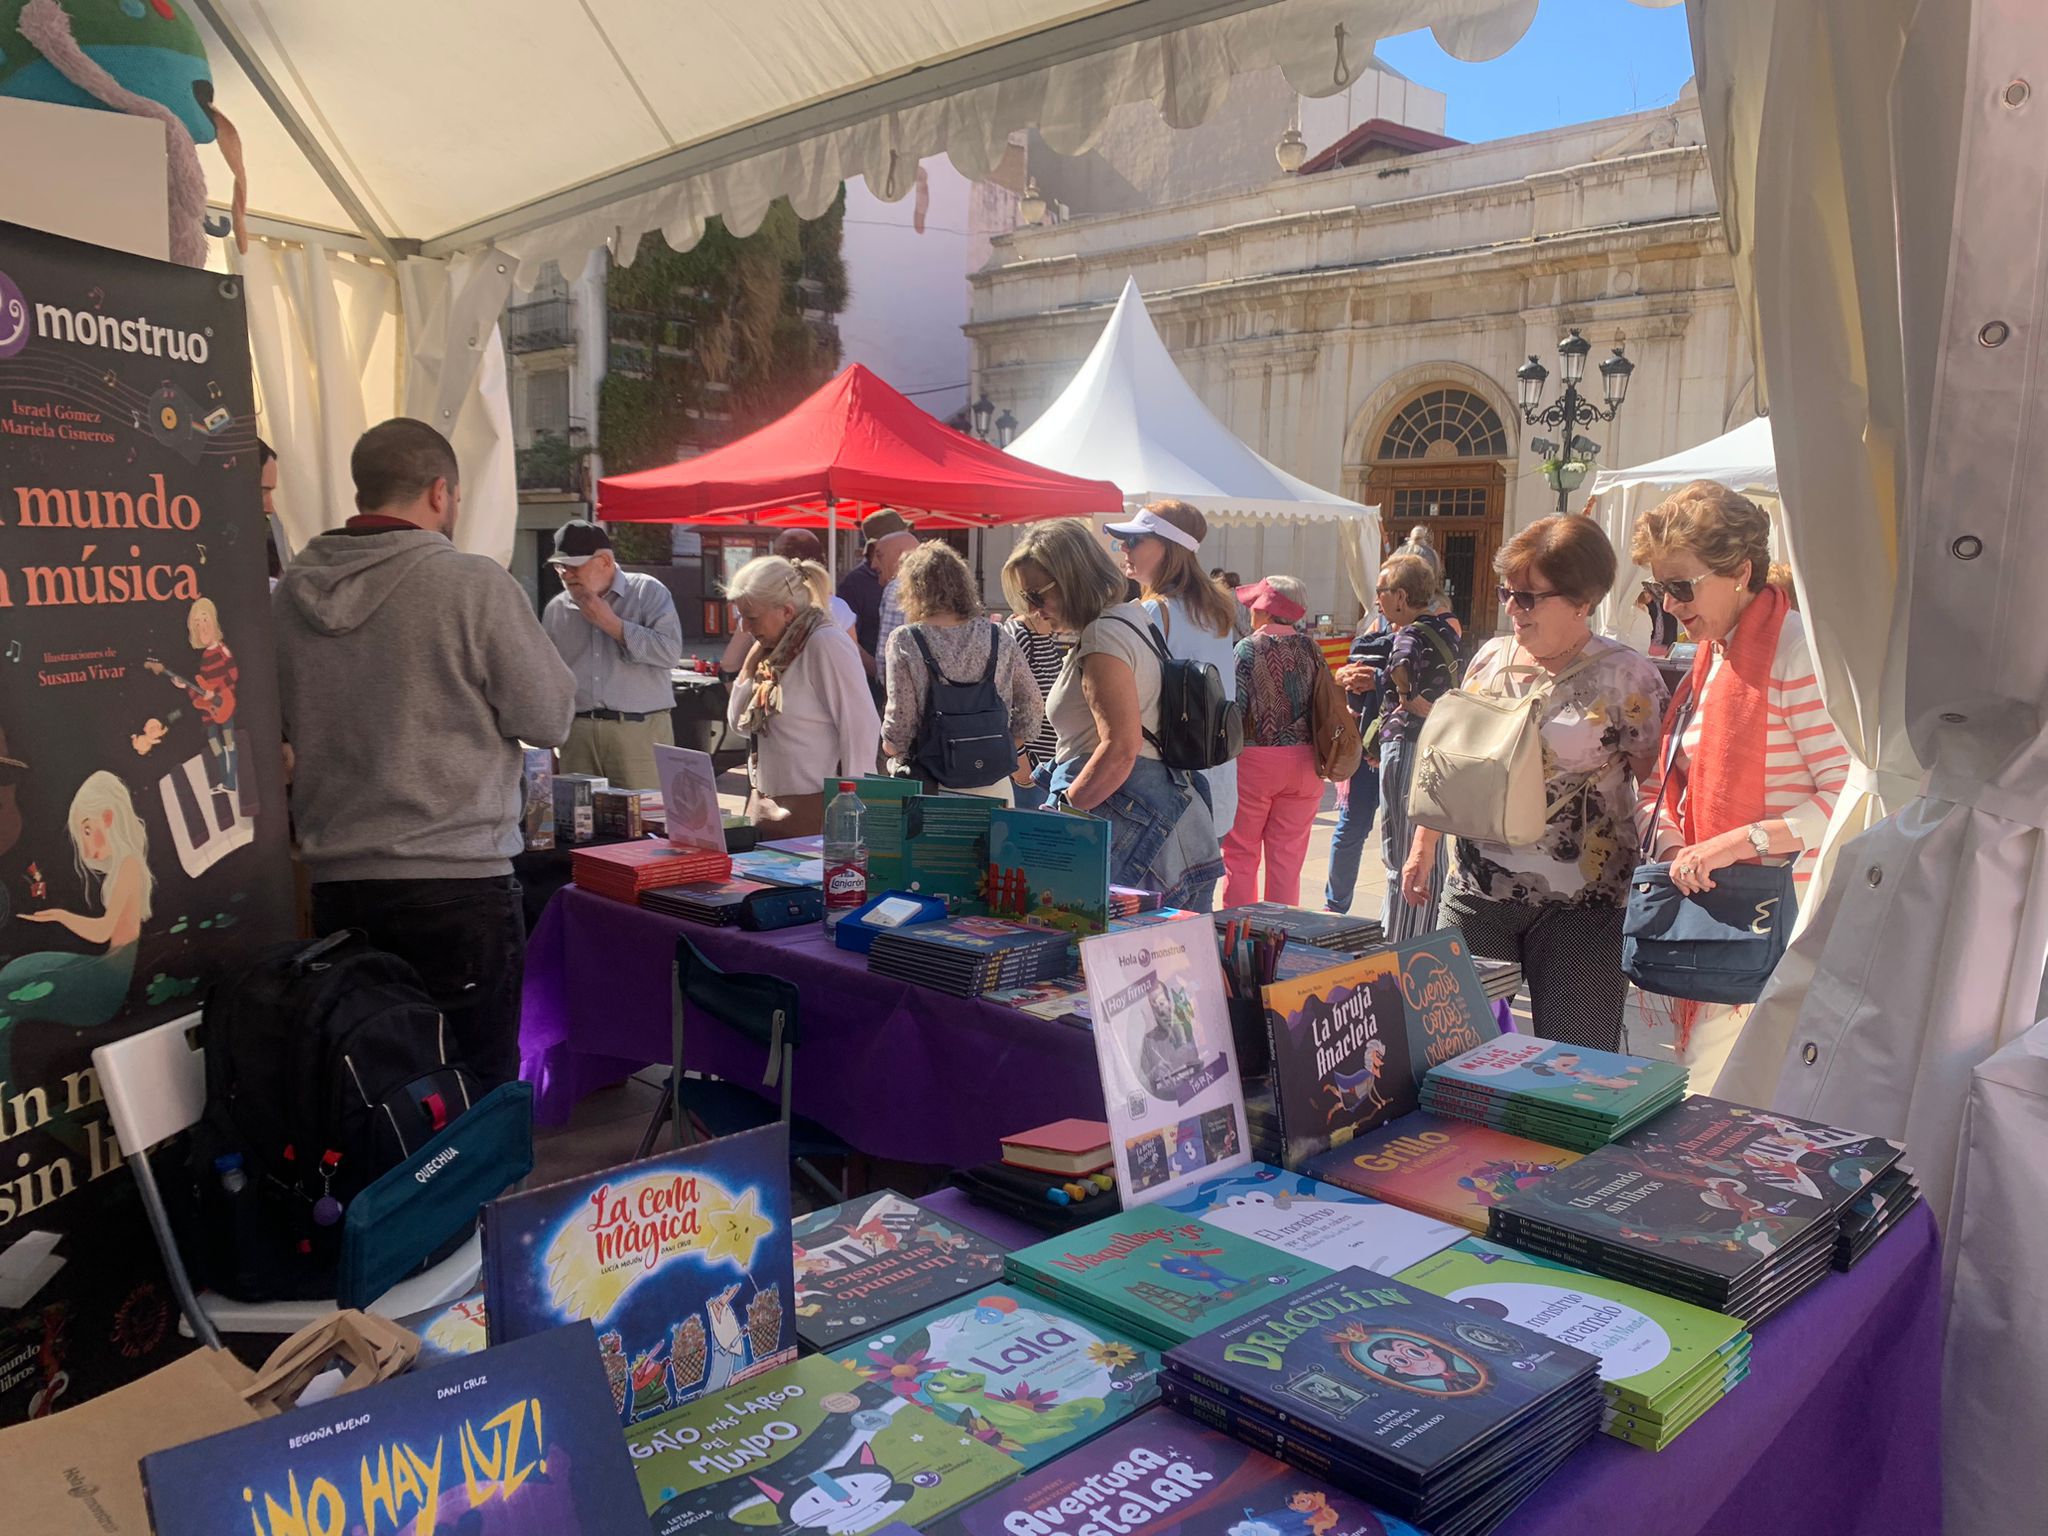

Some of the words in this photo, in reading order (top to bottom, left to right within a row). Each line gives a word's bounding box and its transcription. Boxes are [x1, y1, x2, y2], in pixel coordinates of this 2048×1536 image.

[35, 303, 209, 364] monstruo
[12, 400, 50, 418] Israel
[54, 403, 101, 424] Gómez
[1, 418, 55, 438] Mariela
[58, 424, 116, 443] Cisneros
[13, 474, 201, 530] mundo
[21, 545, 202, 606] música
[38, 669, 87, 686] Susana
[90, 664, 126, 681] Vivar
[831, 878, 864, 890] Lanjarón
[1118, 954, 1137, 967] Hola
[1151, 944, 1186, 960] monstruo
[1107, 994, 1127, 1014] Hoy
[1127, 978, 1152, 1001] firma
[1401, 960, 1461, 1010] Cuentos
[1312, 1017, 1331, 1047] La
[1332, 985, 1373, 1032] bruja
[1422, 1001, 1463, 1035] cortos
[1316, 1012, 1378, 1081] Anacleta
[1424, 1024, 1481, 1067] valientes
[1459, 1048, 1509, 1071] MALAS
[1490, 1045, 1544, 1070] PULGAS
[1694, 1119, 1732, 1146] mundo
[1721, 1126, 1755, 1152] música
[415, 1146, 460, 1183] QUECHUA
[1353, 1131, 1450, 1171] Grillo
[587, 1183, 633, 1233] La
[639, 1176, 700, 1219] cena
[1567, 1193, 1594, 1210] Un
[1591, 1169, 1643, 1203] mundo
[1604, 1198, 1626, 1215] sin
[1619, 1179, 1665, 1210] libros
[595, 1207, 702, 1270] mágica
[1254, 1229, 1283, 1242] El
[1279, 1207, 1336, 1237] monstruo
[918, 1255, 957, 1271] Un
[836, 1263, 917, 1300] mundo
[1224, 1285, 1413, 1371] DRACULÍN
[1525, 1293, 1584, 1328] monstruo
[968, 1327, 1077, 1375] Lala
[0, 1367, 35, 1393] libros
[436, 1384, 462, 1400] DANI
[463, 1375, 488, 1390] CRUZ
[725, 1385, 806, 1416] LARGO
[1373, 1408, 1400, 1425] LETRA
[289, 1427, 333, 1449] BEGOÑA
[334, 1413, 371, 1435] BUENO
[706, 1415, 742, 1435] MÁS
[1375, 1408, 1421, 1437] MAYÚSCULA
[1391, 1432, 1418, 1449] TEXTO
[1416, 1413, 1445, 1434] RIMADO
[1403, 1422, 1413, 1430] Y
[630, 1427, 702, 1459] GATO
[688, 1421, 801, 1475] MUNDO
[703, 1438, 732, 1452] DEL
[360, 1435, 443, 1536] HAY
[458, 1398, 547, 1508] LUZ!
[661, 1508, 714, 1536] MAYÚSCULA
[667, 1509, 696, 1526] LETRA
